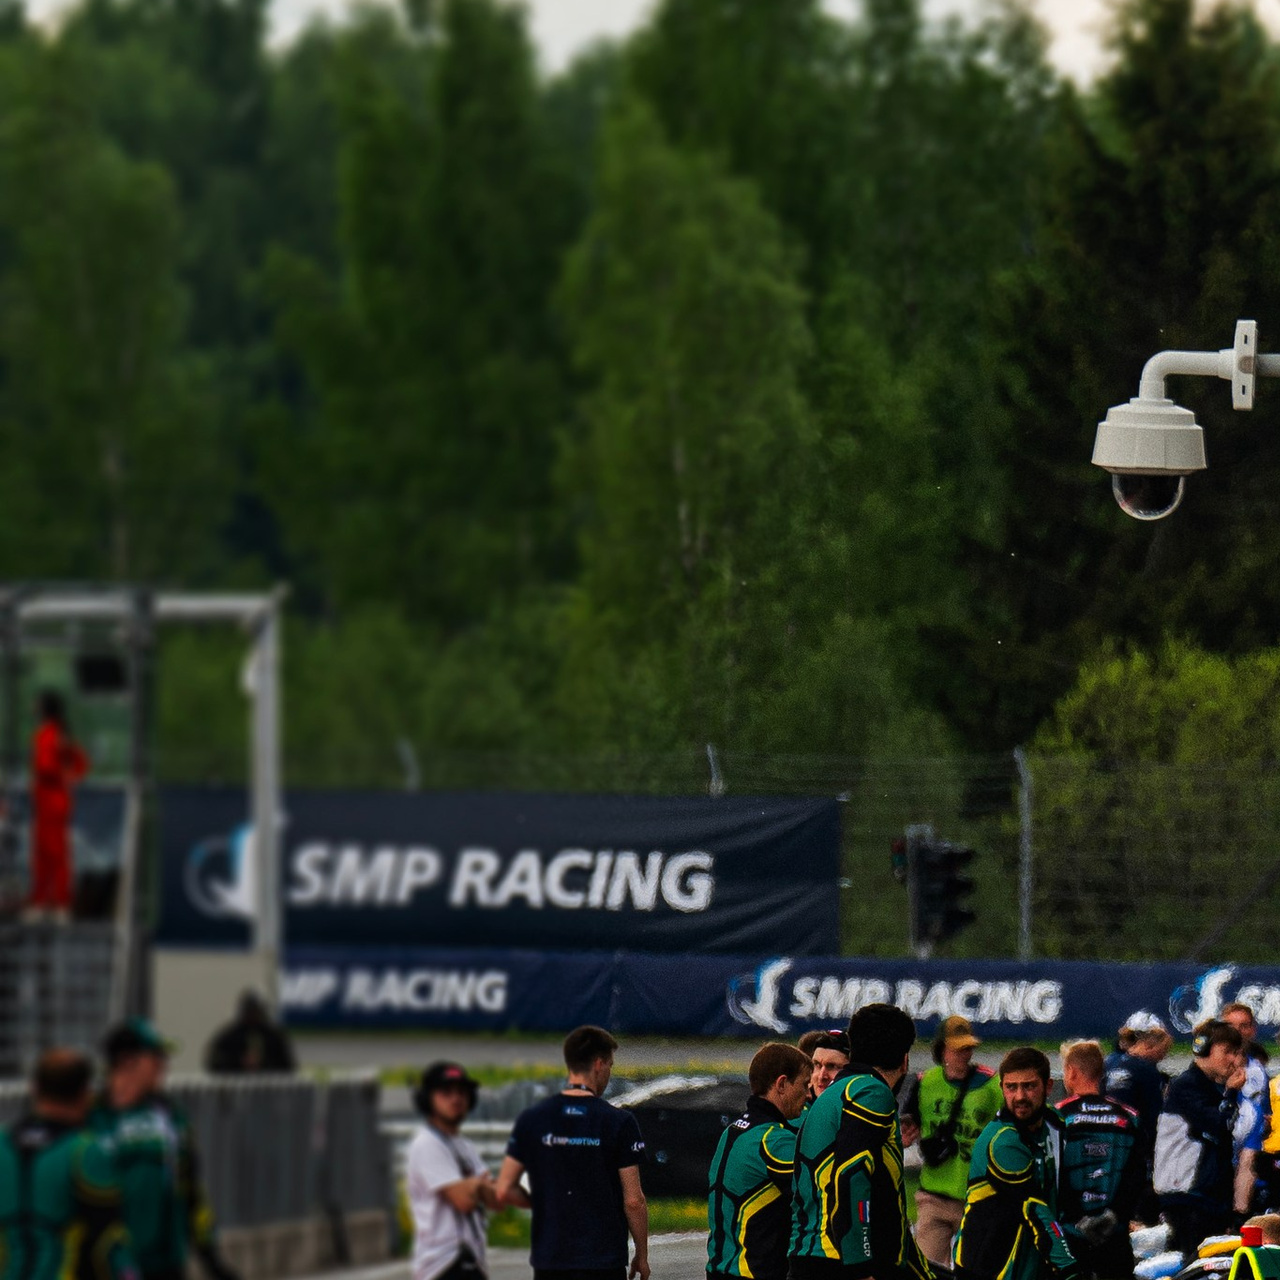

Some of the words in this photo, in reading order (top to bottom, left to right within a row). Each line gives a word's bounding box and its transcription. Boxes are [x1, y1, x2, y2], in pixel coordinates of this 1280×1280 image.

[290, 846, 440, 904] SMP
[449, 849, 715, 913] RACING
[345, 972, 508, 1012] RACING
[790, 977, 888, 1019] SMP
[896, 980, 1062, 1024] RACING
